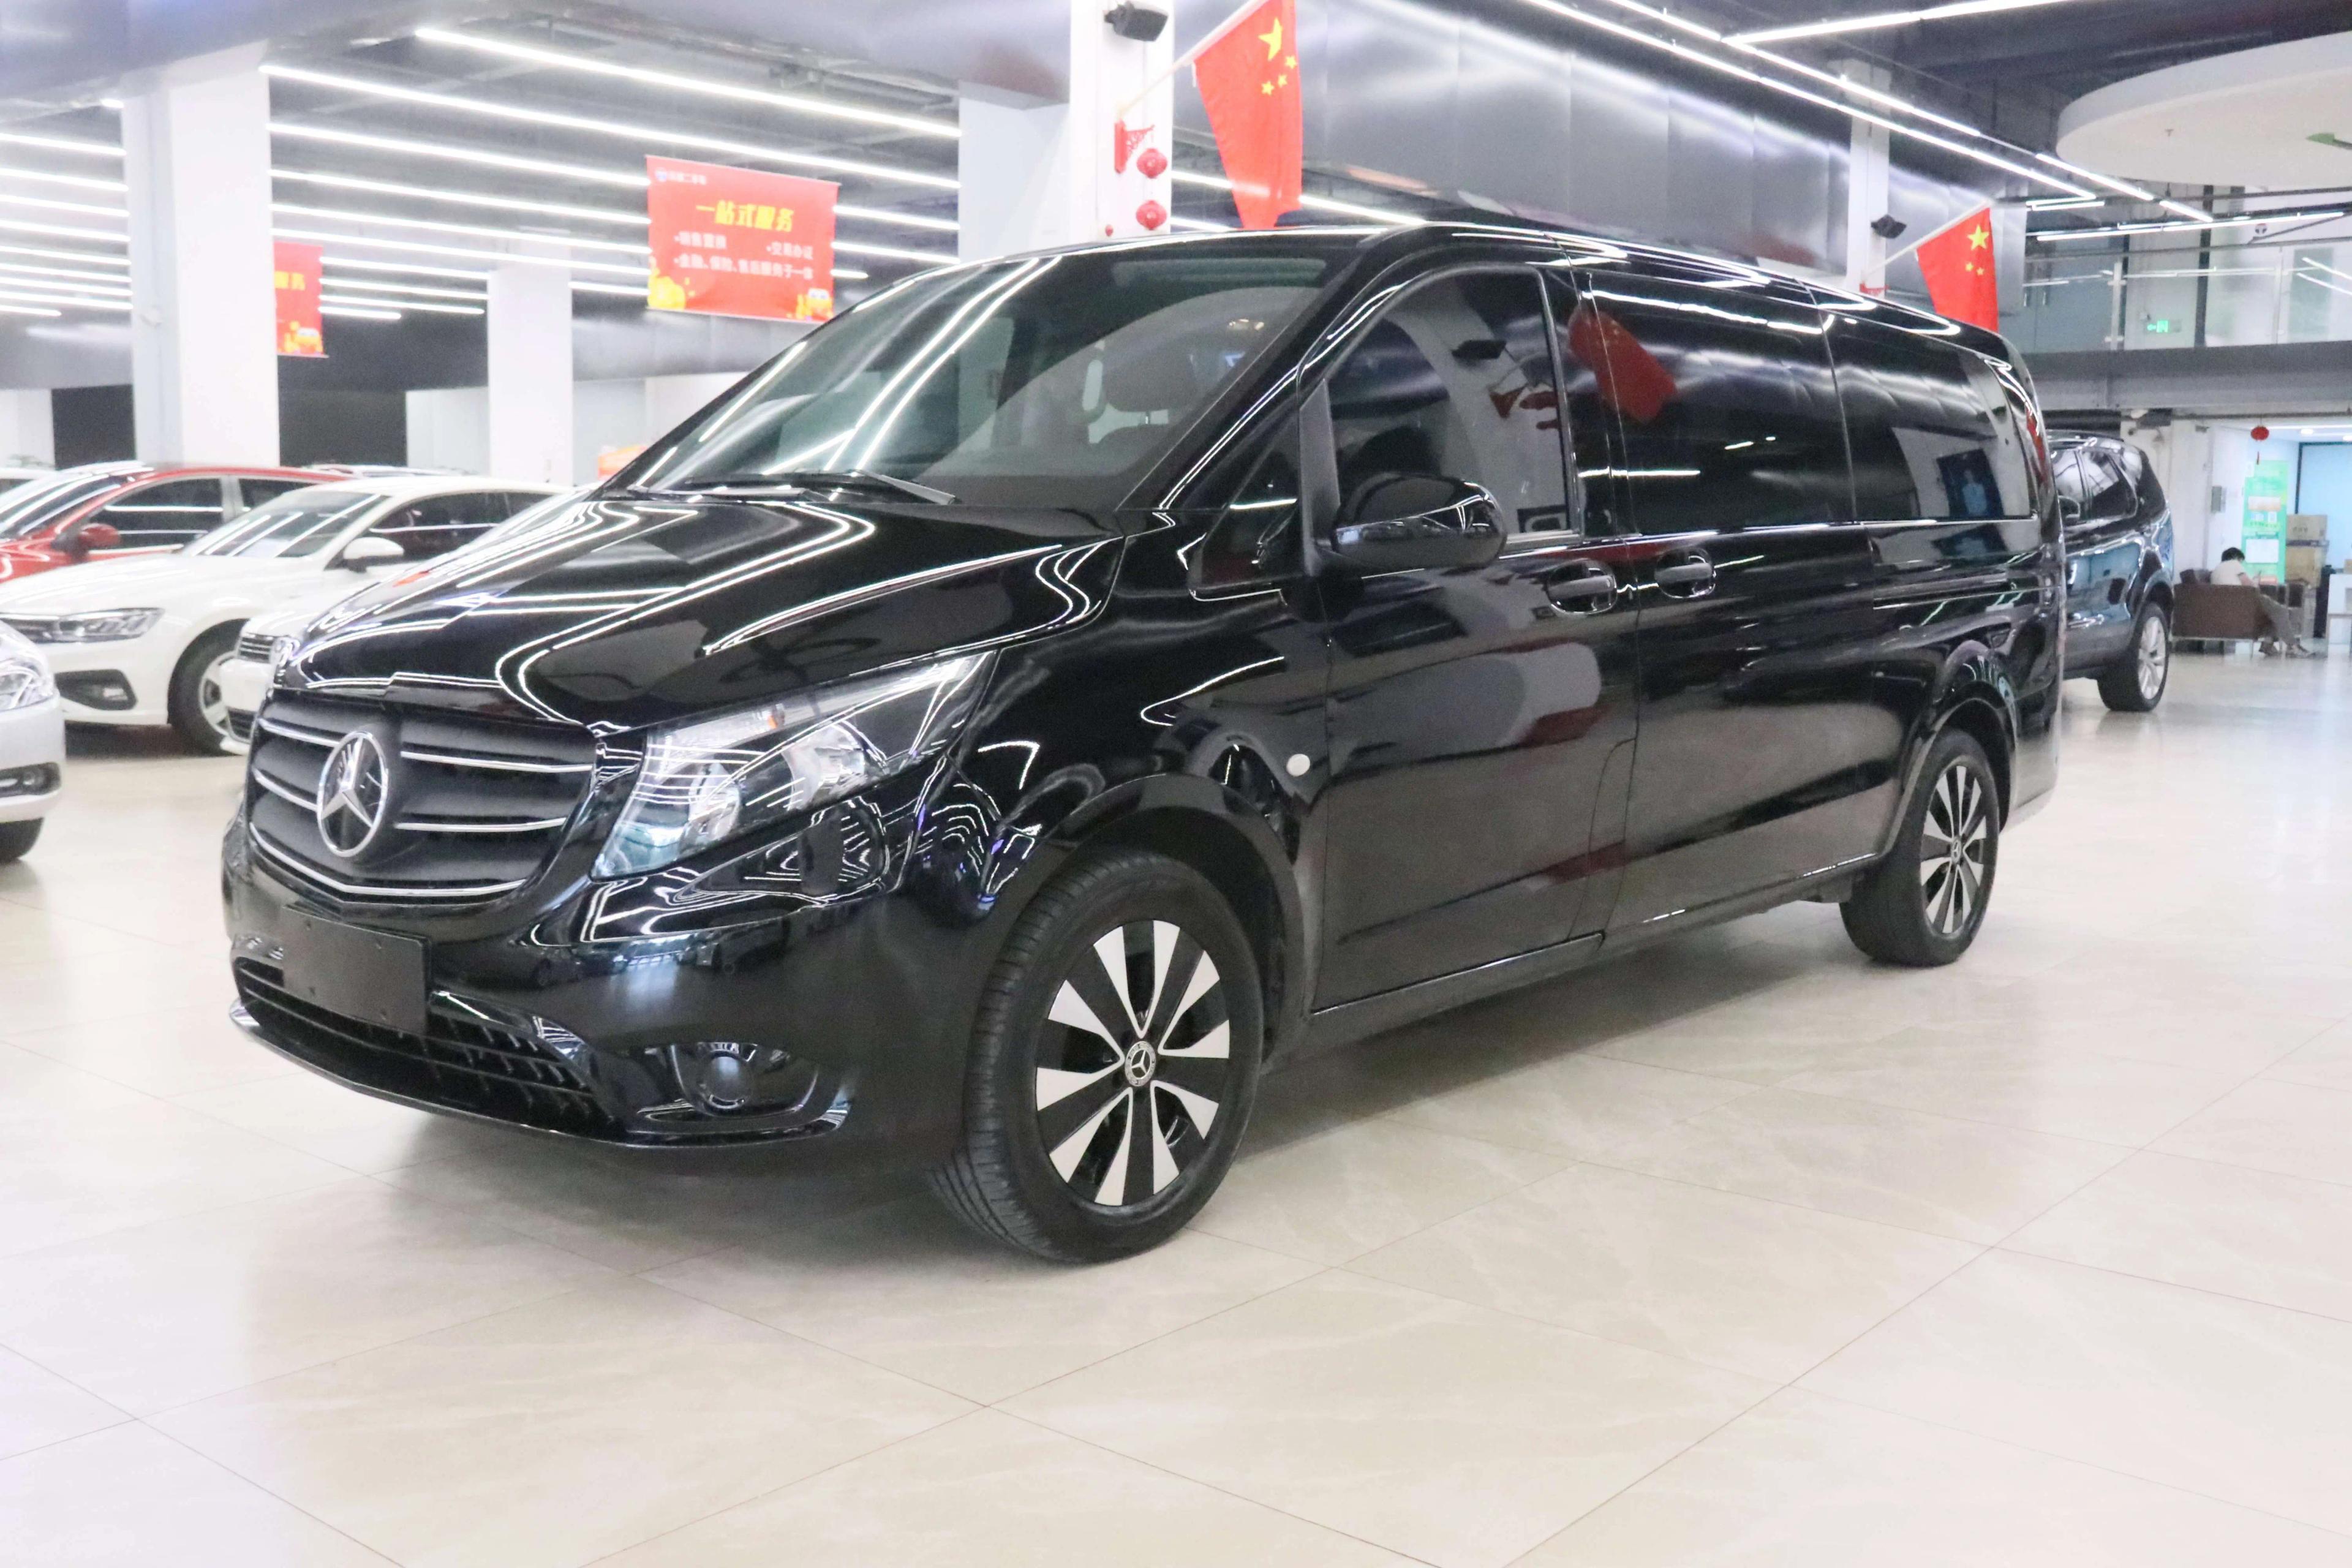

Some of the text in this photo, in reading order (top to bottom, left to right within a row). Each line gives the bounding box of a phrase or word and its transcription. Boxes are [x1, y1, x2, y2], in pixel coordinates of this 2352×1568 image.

[695, 200, 794, 232] 一站式服务
